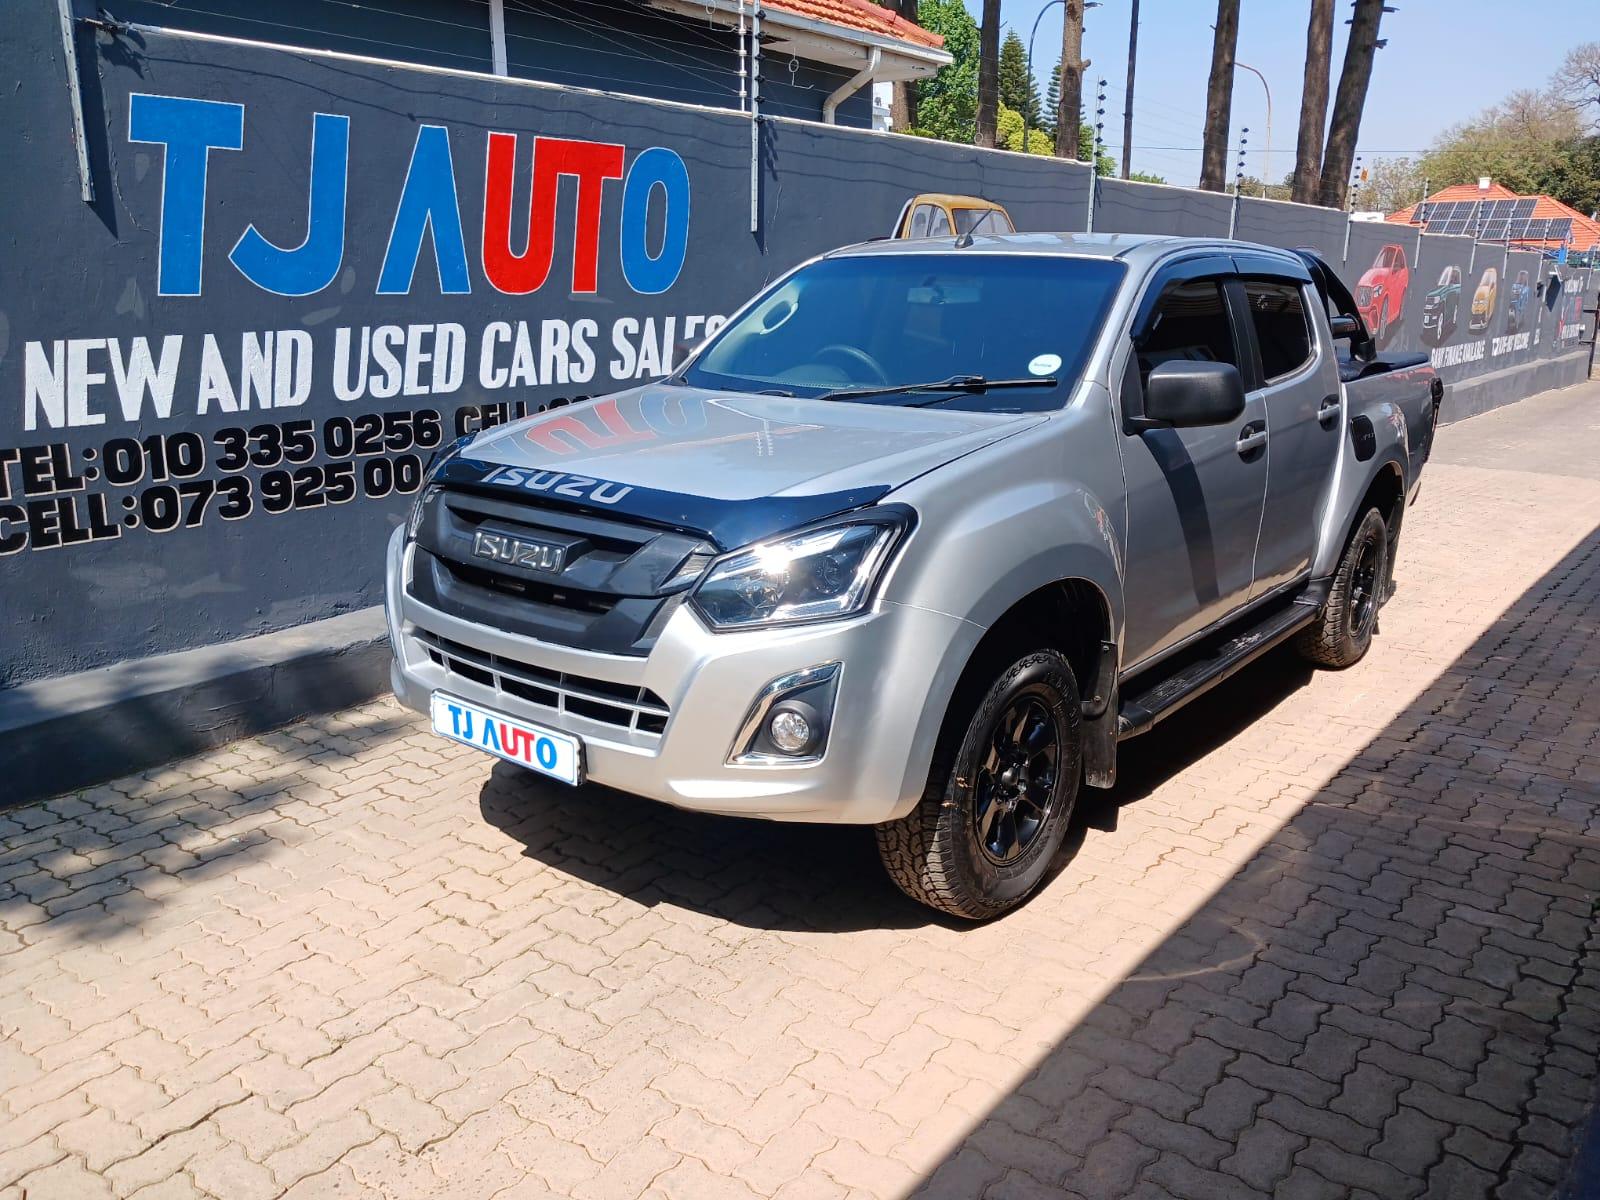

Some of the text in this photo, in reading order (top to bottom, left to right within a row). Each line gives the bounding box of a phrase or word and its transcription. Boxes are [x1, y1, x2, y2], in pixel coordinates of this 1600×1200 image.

[128, 93, 691, 297] TJ AUTO
[23, 315, 728, 431] NEW AND USED CARS SAL
[213, 420, 317, 473] 335
[323, 409, 442, 460] 0256
[260, 461, 357, 515] 925
[480, 466, 635, 504] ISUZU
[473, 531, 566, 574] ISUZU
[448, 704, 558, 770] TJ AUTO
